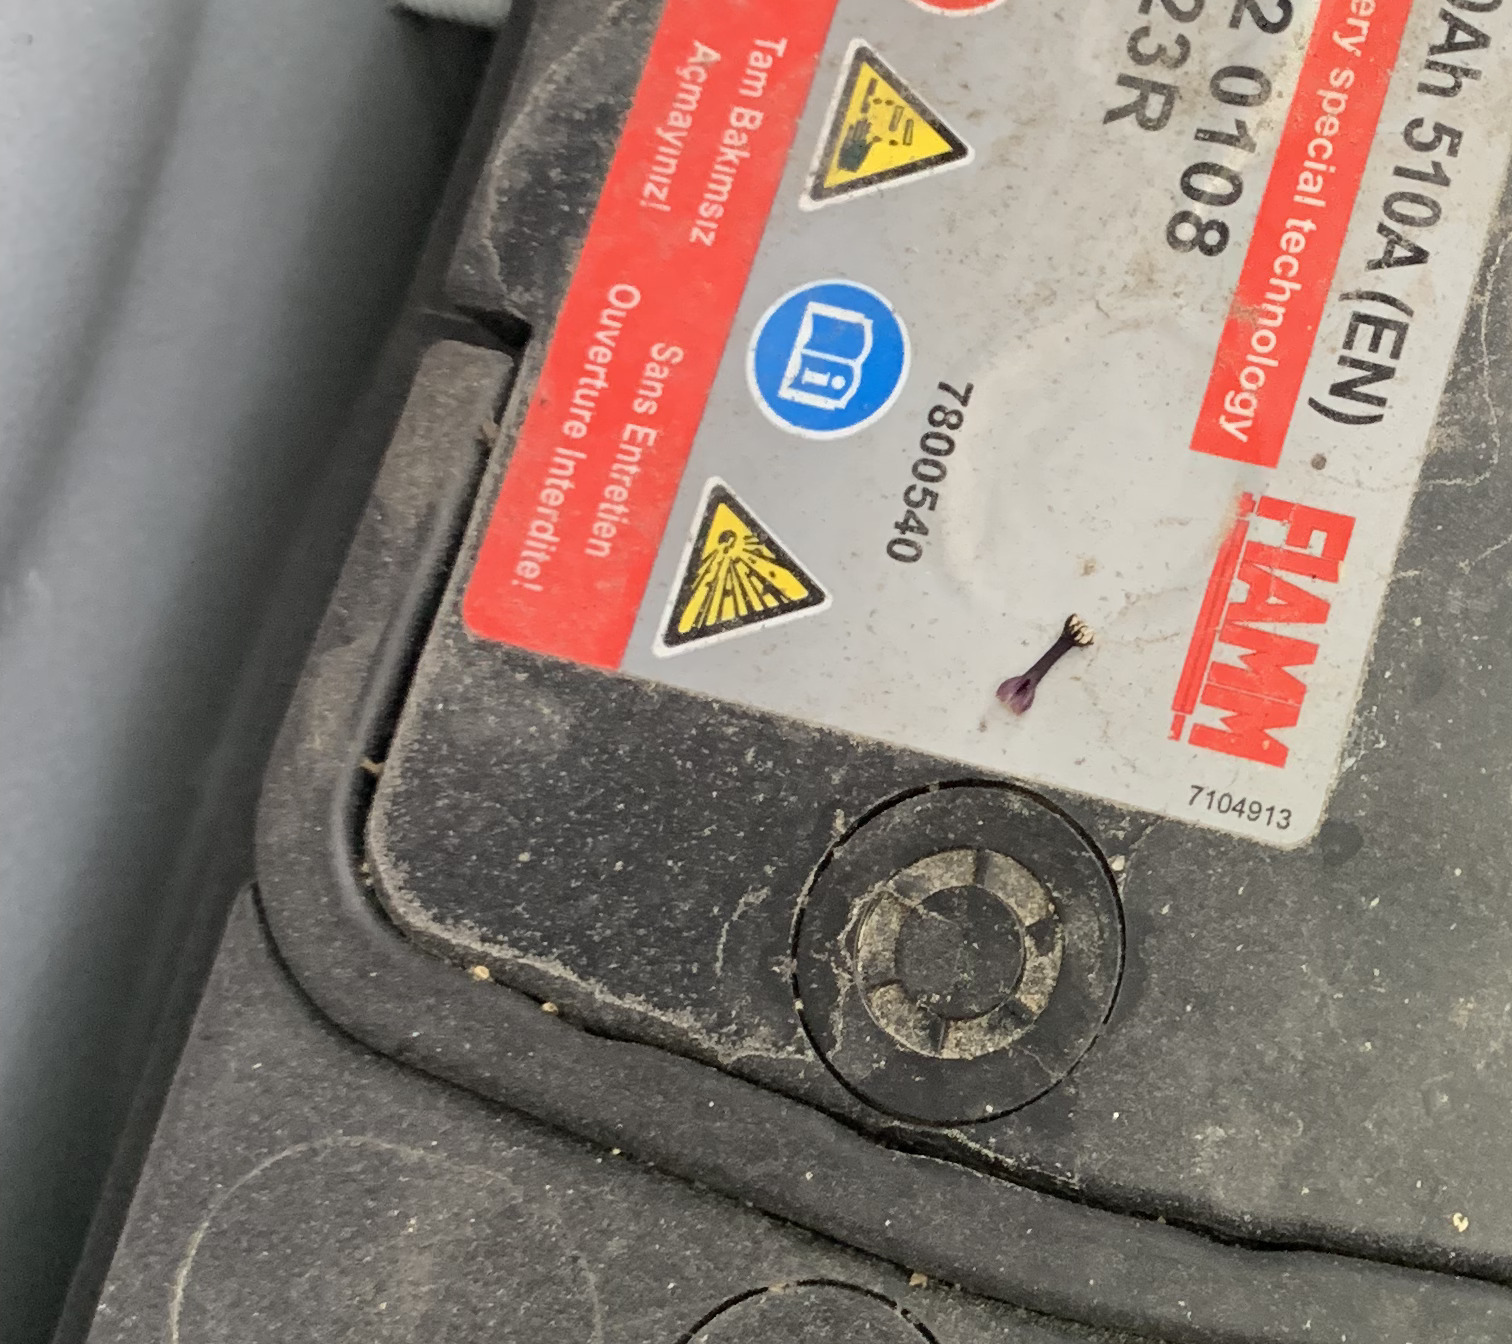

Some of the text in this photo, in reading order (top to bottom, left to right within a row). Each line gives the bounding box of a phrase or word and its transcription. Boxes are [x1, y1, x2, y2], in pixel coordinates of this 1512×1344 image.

[639, 39, 721, 211] Açmayınız!
[688, 37, 787, 246] Tam Bakımsız
[1165, 64, 1272, 257] 0108
[1292, 67, 1354, 207] special
[1365, 117, 1463, 270] 510A
[1218, 218, 1316, 442] technology
[1307, 289, 1414, 425] (EN)
[511, 283, 641, 591] Ouverture Interdite!
[584, 342, 684, 557] Sans Entretien
[885, 381, 974, 563] 7800540
[1187, 495, 1356, 768] FIAMM
[1188, 784, 1292, 830] 7104913
